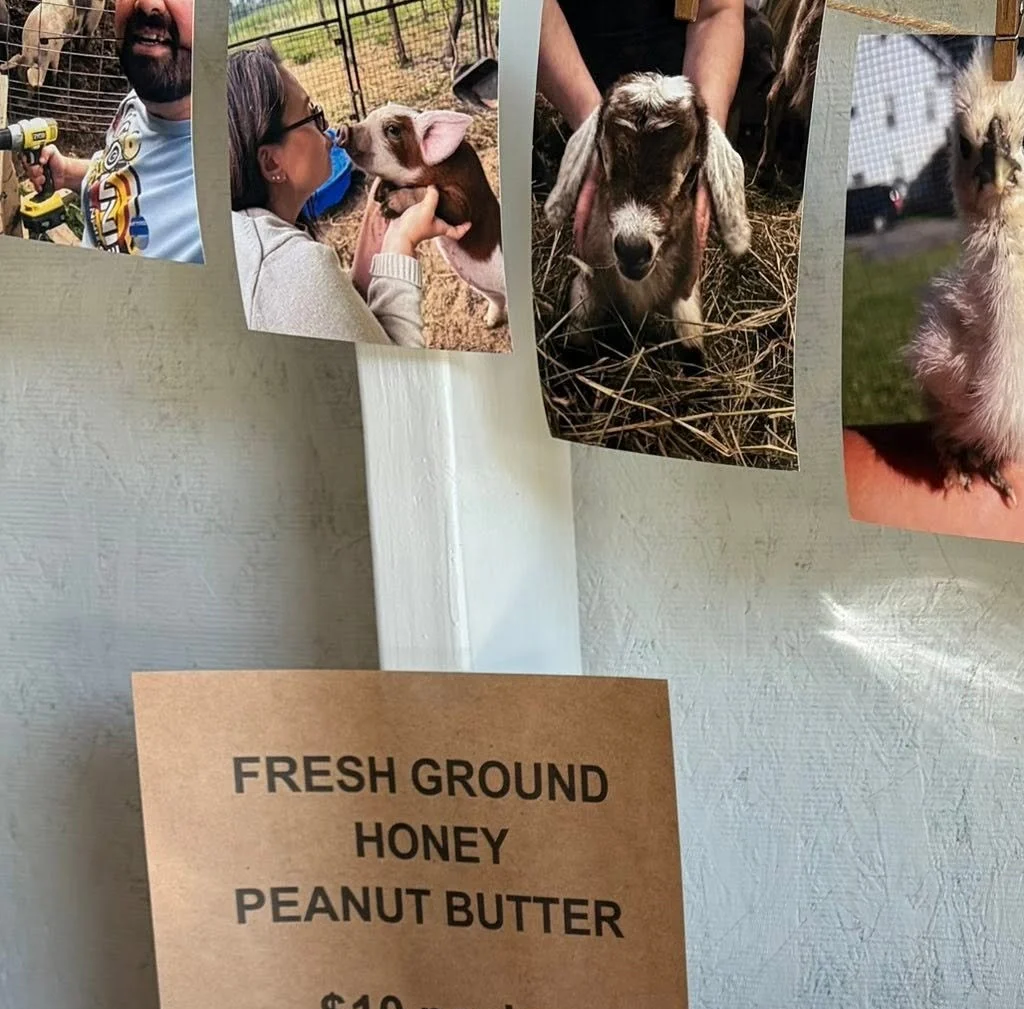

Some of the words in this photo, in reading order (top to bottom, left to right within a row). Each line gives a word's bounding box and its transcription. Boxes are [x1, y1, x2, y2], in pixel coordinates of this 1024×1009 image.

[232, 754, 397, 795] FRESH
[410, 757, 609, 804] GROUND
[354, 821, 510, 865] HONEY
[234, 885, 432, 925] PEANUT
[445, 889, 625, 939] BUTTER
